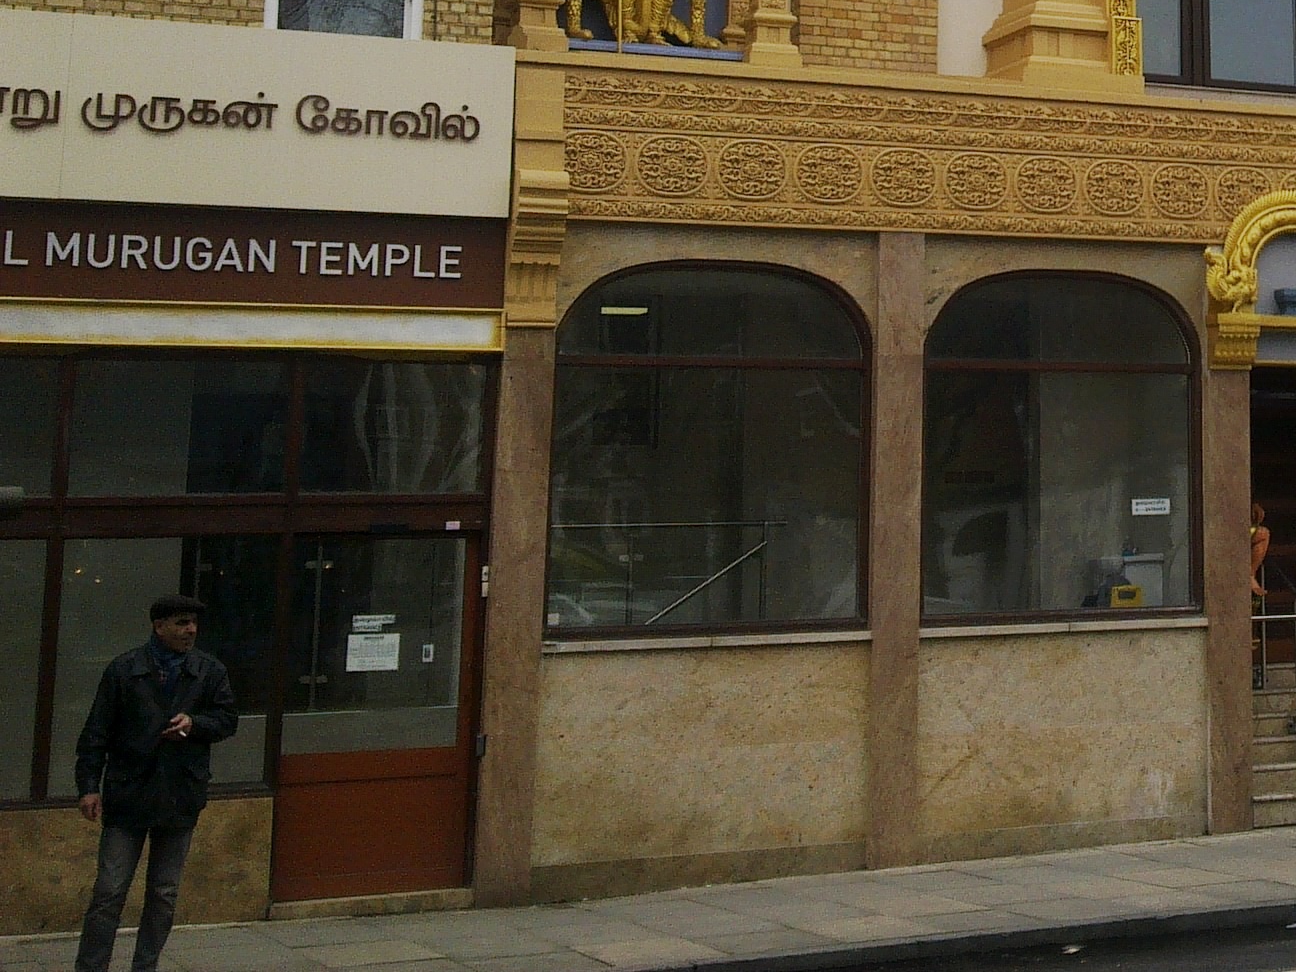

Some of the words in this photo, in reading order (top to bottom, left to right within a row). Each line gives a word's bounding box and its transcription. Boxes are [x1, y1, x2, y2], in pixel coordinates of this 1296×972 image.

[81, 91, 279, 132] முருகன்
[295, 94, 480, 142] கோவில்
[4, 230, 29, 266] L
[45, 231, 277, 273] MURUGAN
[291, 240, 463, 279] TEMPLE
